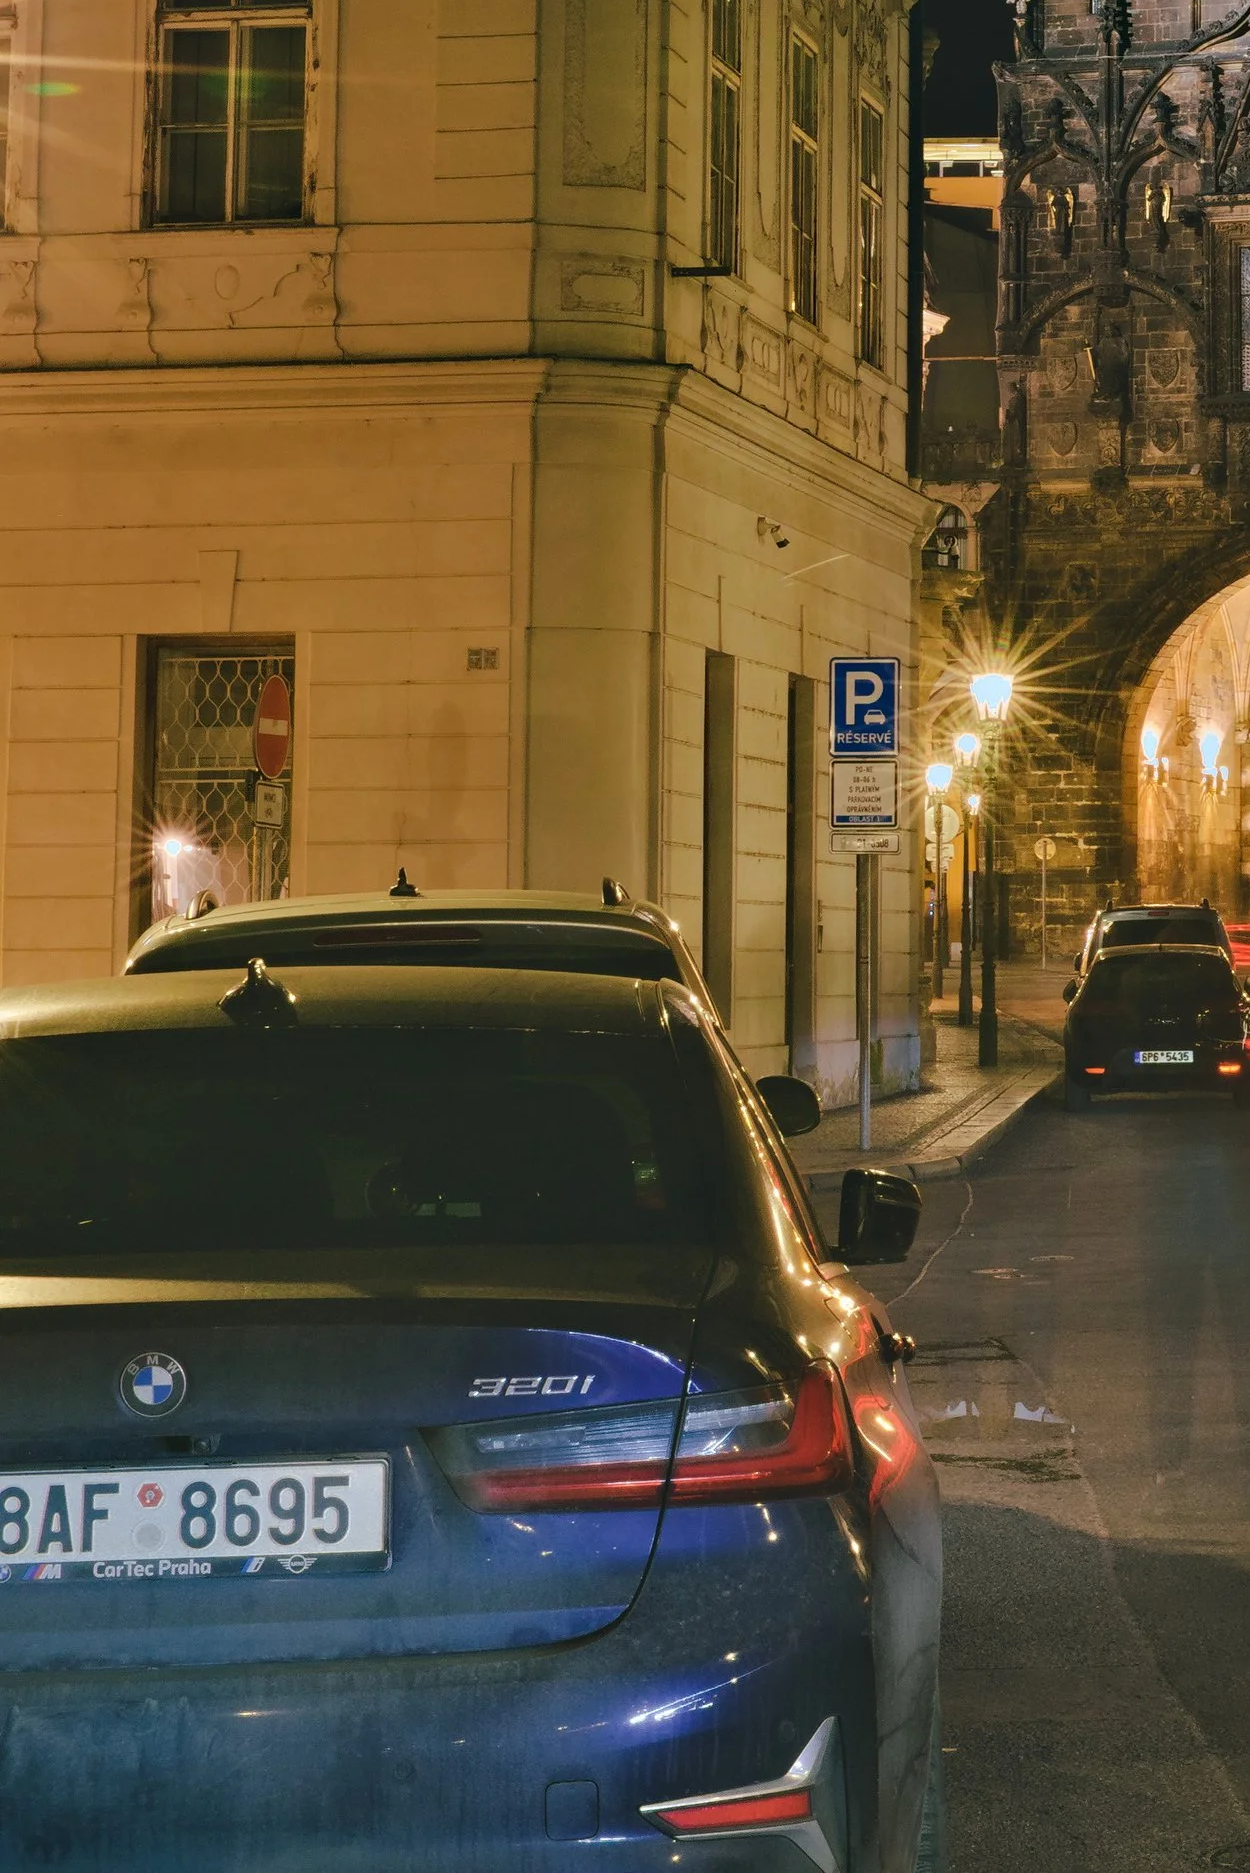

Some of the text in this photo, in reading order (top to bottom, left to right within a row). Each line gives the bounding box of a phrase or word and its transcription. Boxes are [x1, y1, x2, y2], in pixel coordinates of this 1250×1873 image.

[846, 671, 883, 725] P
[837, 730, 892, 744] RÉSERVÉ
[127, 1355, 180, 1375] BMW
[468, 1375, 596, 1397] 320i
[0, 1476, 350, 1555] 8AF 8695
[93, 1559, 212, 1577] CarTec Praha
